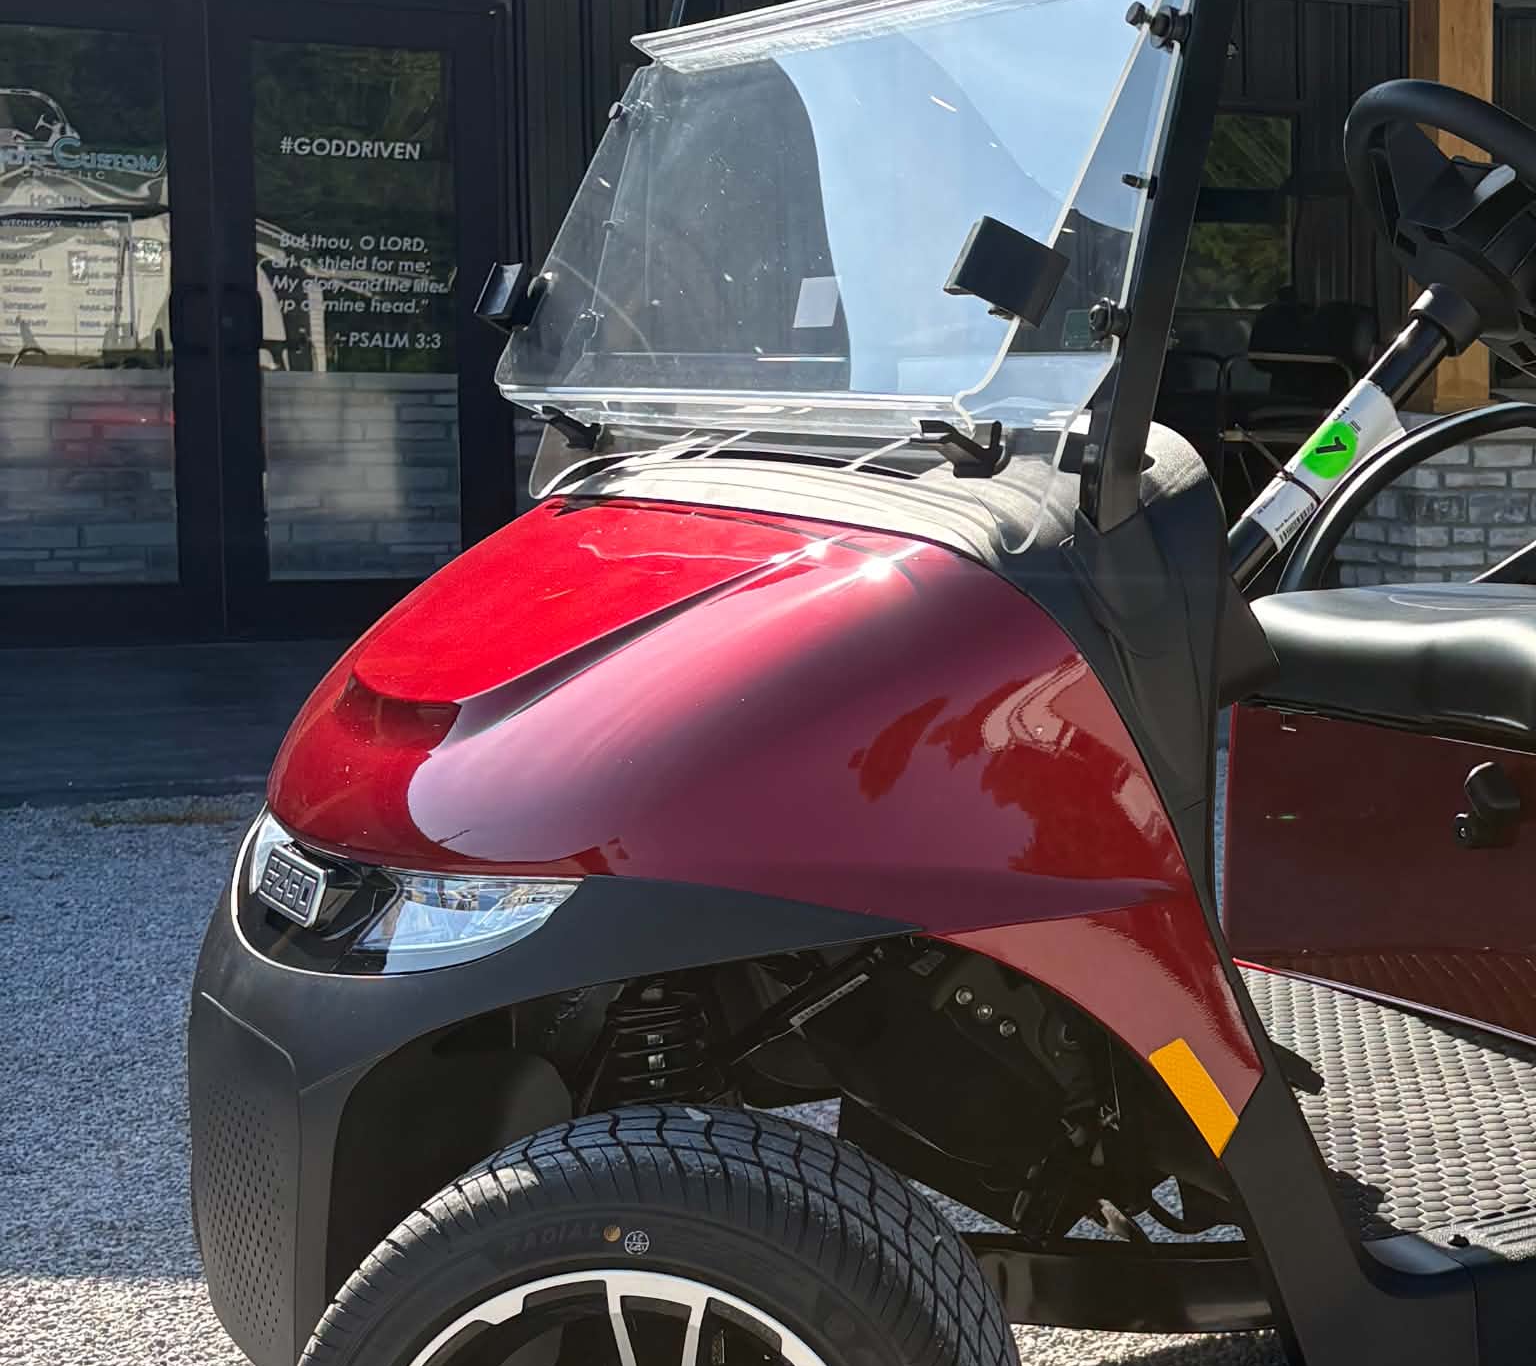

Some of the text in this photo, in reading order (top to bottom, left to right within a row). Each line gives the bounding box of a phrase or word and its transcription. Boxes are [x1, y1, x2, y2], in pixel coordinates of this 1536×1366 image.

[53, 137, 158, 172] CUSTOM
[280, 137, 421, 160] #GODDRIVEN
[360, 236, 375, 251] O
[380, 236, 429, 253] LORD,
[318, 255, 368, 272] shield
[372, 255, 395, 272] for
[398, 259, 432, 274] me;
[272, 275, 299, 292] My
[349, 277, 381, 292] and
[323, 298, 368, 313] mine
[415, 334, 441, 349] 3:3
